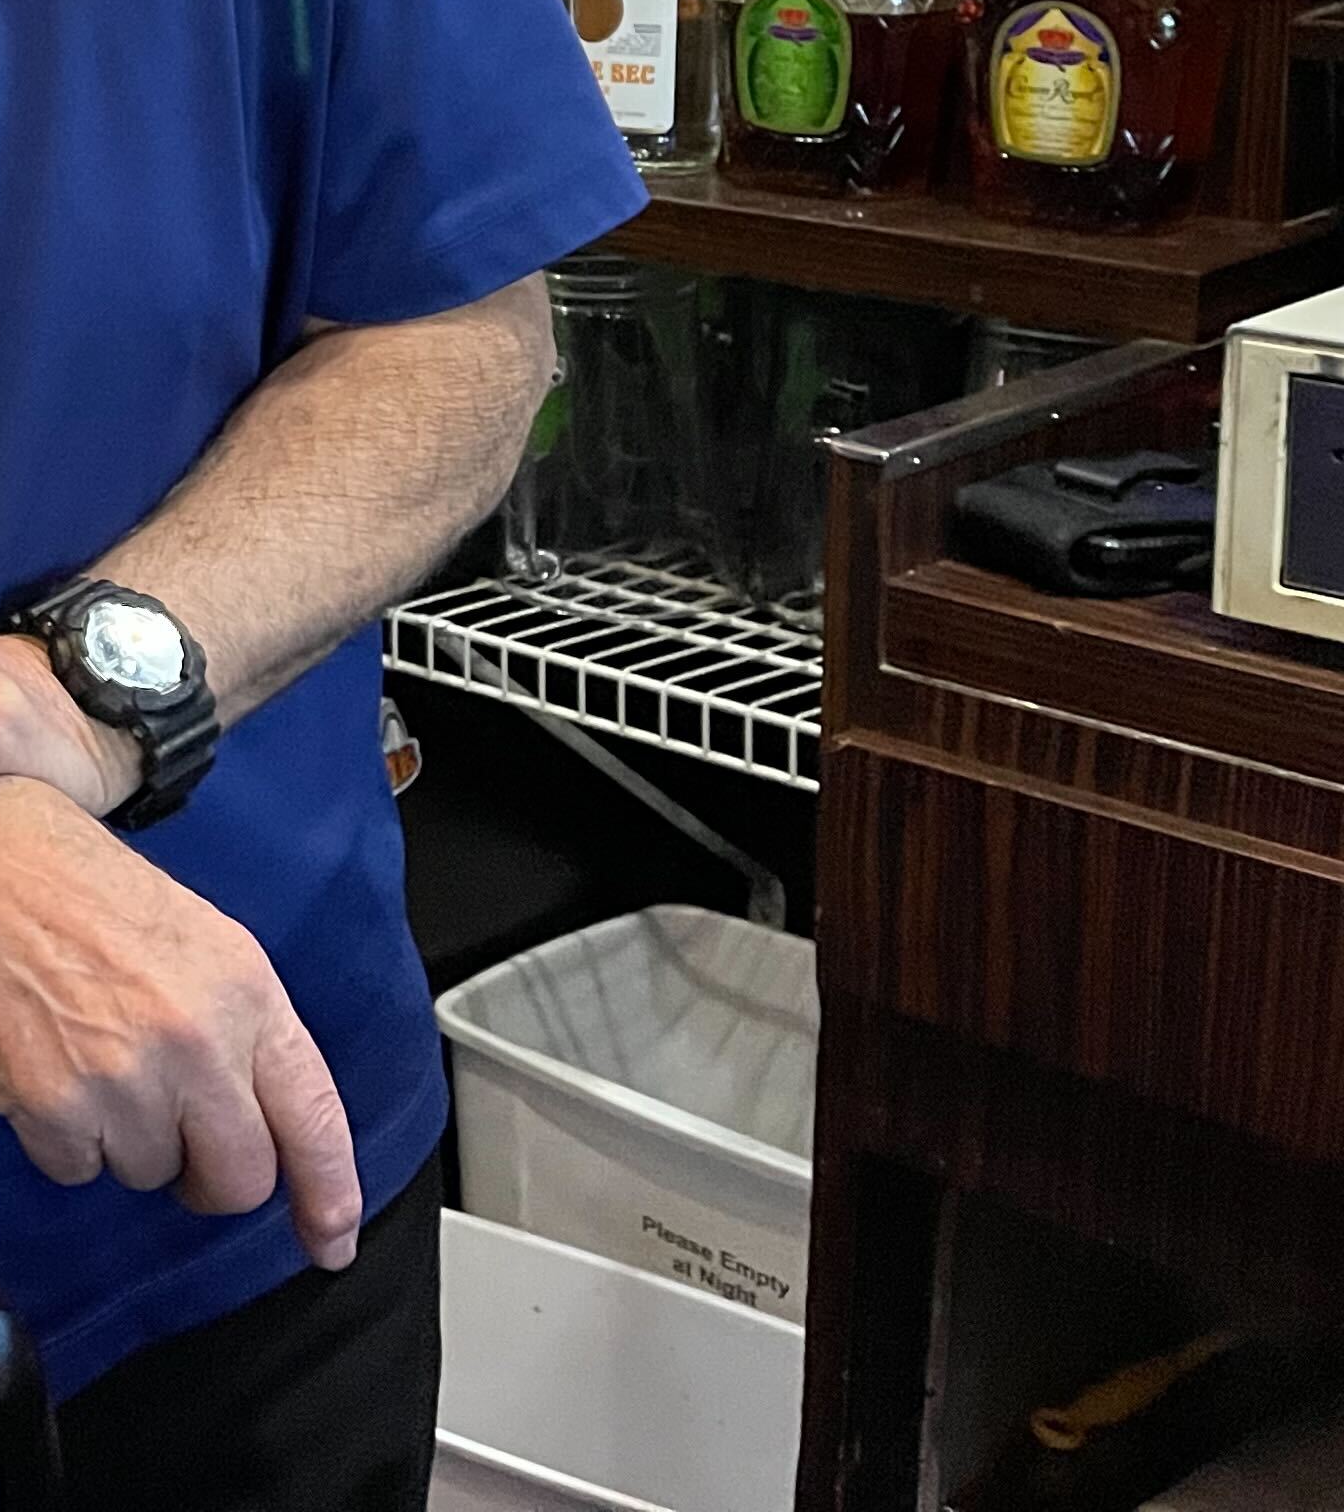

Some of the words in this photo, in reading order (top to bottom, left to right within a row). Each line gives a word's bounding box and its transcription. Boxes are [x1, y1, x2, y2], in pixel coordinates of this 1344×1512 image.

[610, 62, 656, 85] SEC
[641, 1214, 714, 1263] Please
[719, 1249, 792, 1299] Empty
[672, 1255, 693, 1279] at
[699, 1265, 759, 1309] Night
